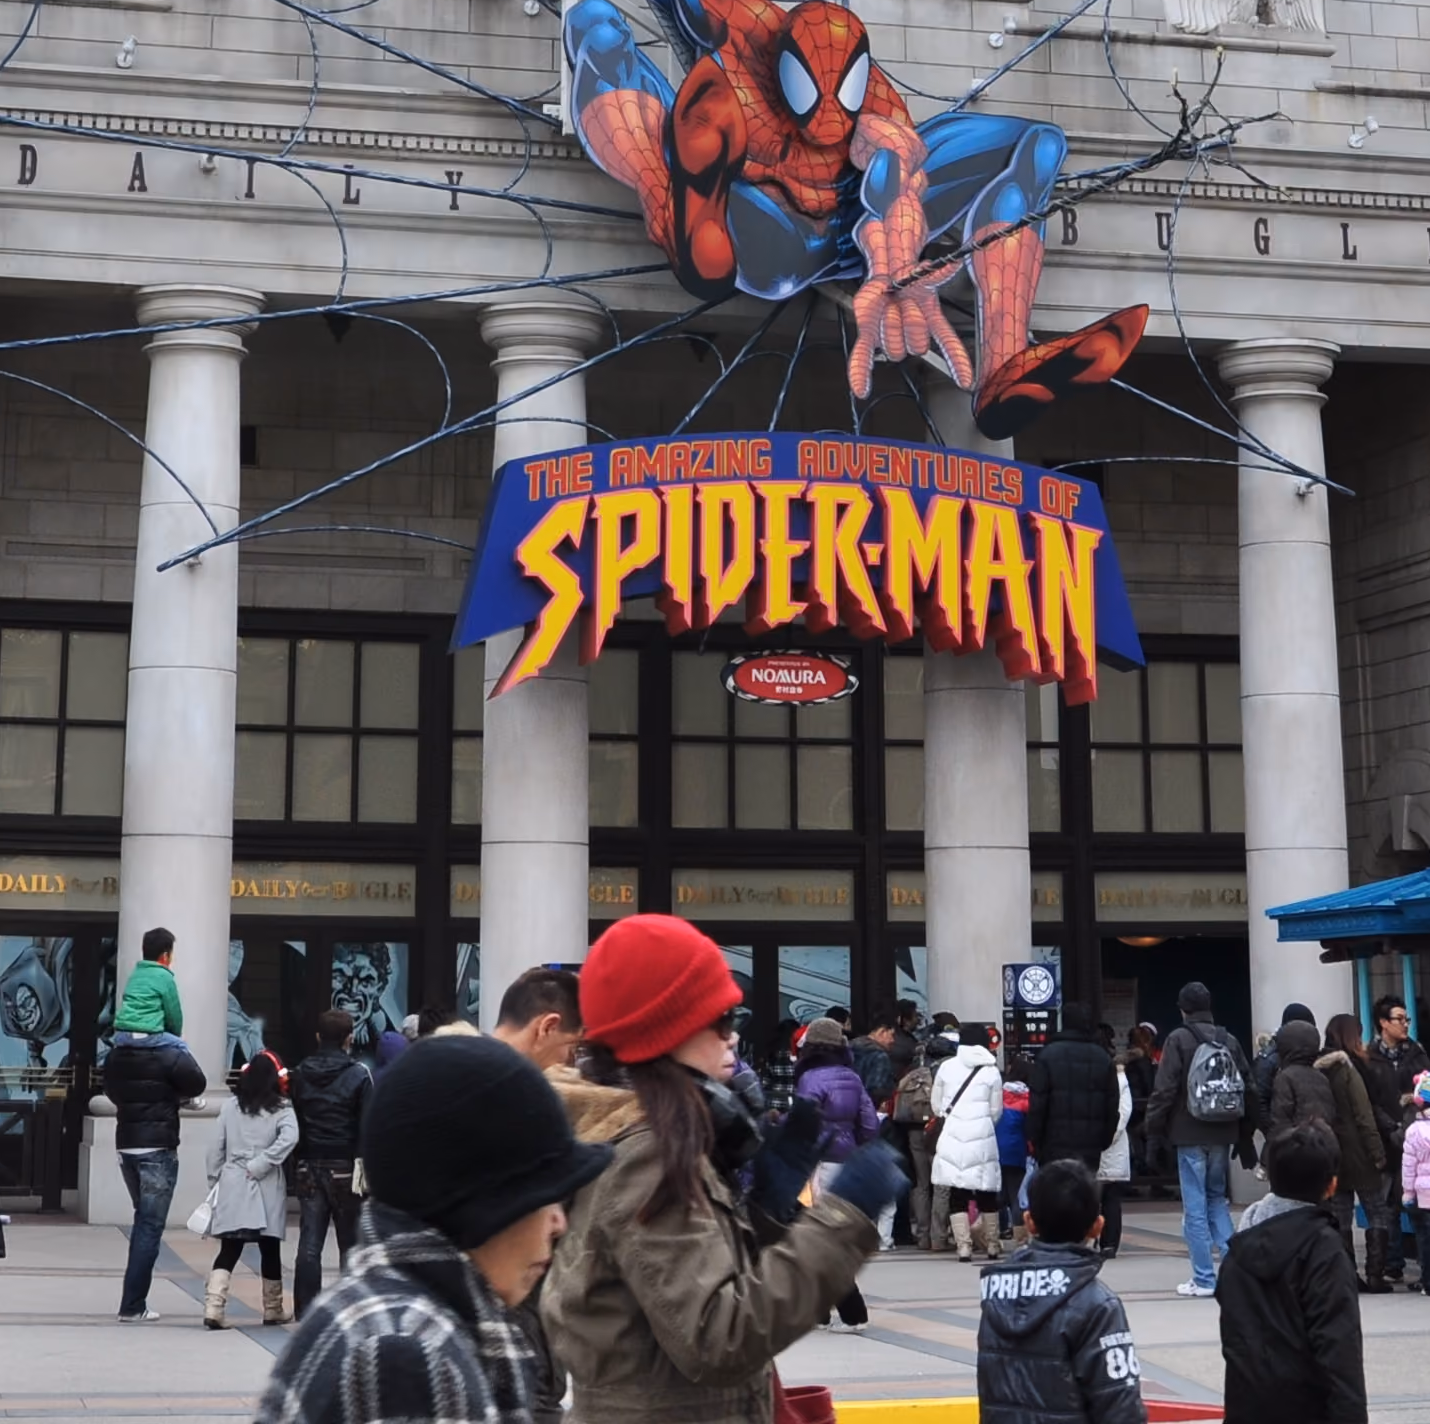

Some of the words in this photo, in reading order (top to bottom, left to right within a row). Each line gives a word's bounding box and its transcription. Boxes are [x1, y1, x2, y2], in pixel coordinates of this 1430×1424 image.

[19, 143, 469, 211] DAILY
[524, 452, 593, 501] THE
[609, 439, 771, 487] AMAZING
[798, 440, 1023, 506] ADVENTURES
[1039, 476, 1081, 519] OF
[486, 480, 1104, 702] SPIDER-MAN
[751, 668, 827, 685] NOMURA
[230, 879, 300, 898] DAILY
[989, 1268, 1049, 1300] PRIDE
[1105, 1346, 1141, 1379] 86
